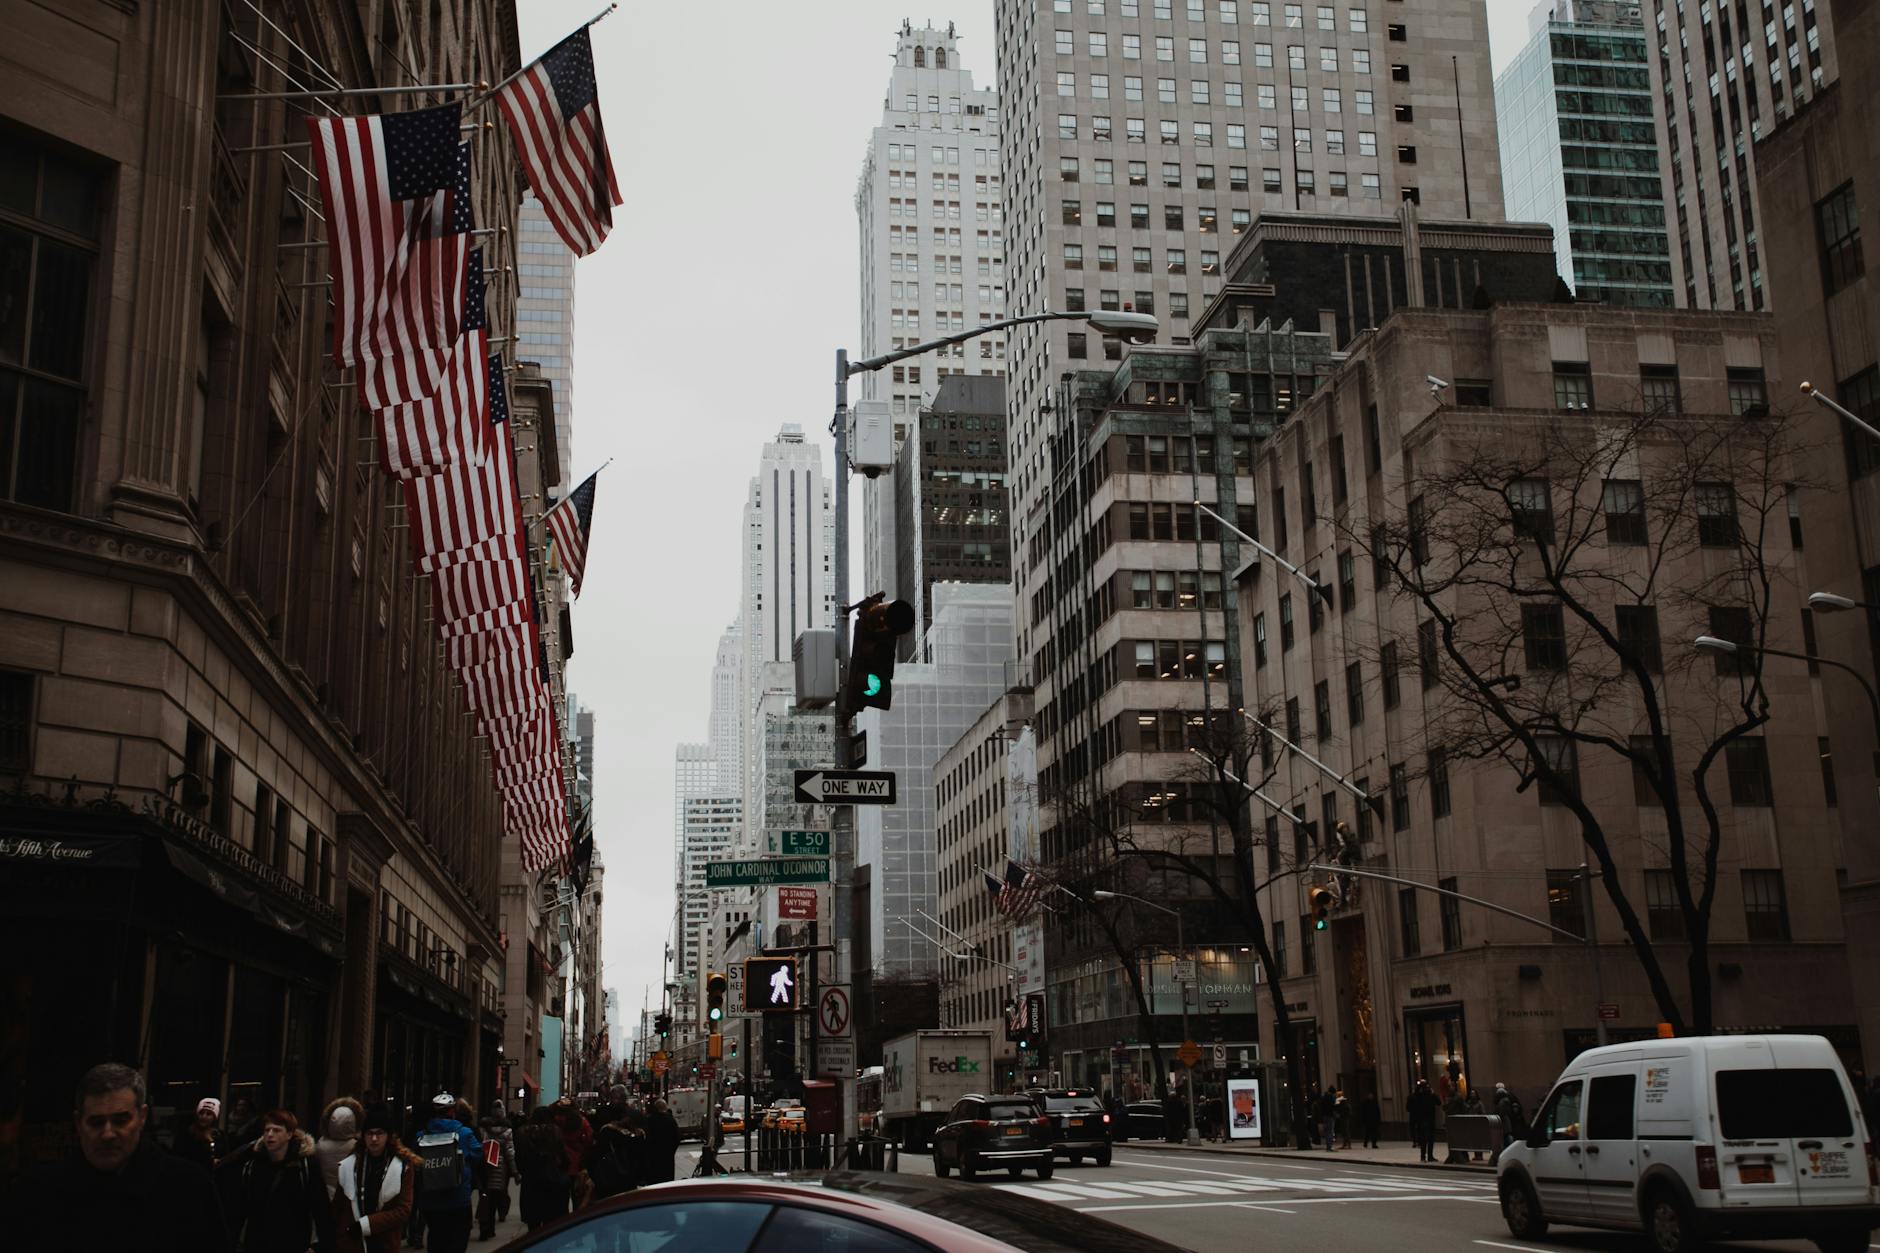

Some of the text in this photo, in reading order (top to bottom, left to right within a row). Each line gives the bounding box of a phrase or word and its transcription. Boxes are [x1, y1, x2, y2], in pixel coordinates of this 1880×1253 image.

[822, 781, 885, 794] ONE WAY
[790, 833, 824, 847] E 50
[44, 840, 94, 859] Avenue
[794, 847, 820, 855] STREET
[708, 863, 733, 878] JOHN
[735, 862, 780, 877] CARDINAL
[780, 889, 816, 899] NO STANDING
[784, 898, 812, 907] ANYTIME
[730, 967, 744, 979] ST
[1031, 1003, 1040, 1034] FRIDAYS
[929, 1056, 980, 1073] FedEx
[425, 1157, 452, 1169] RELAY
